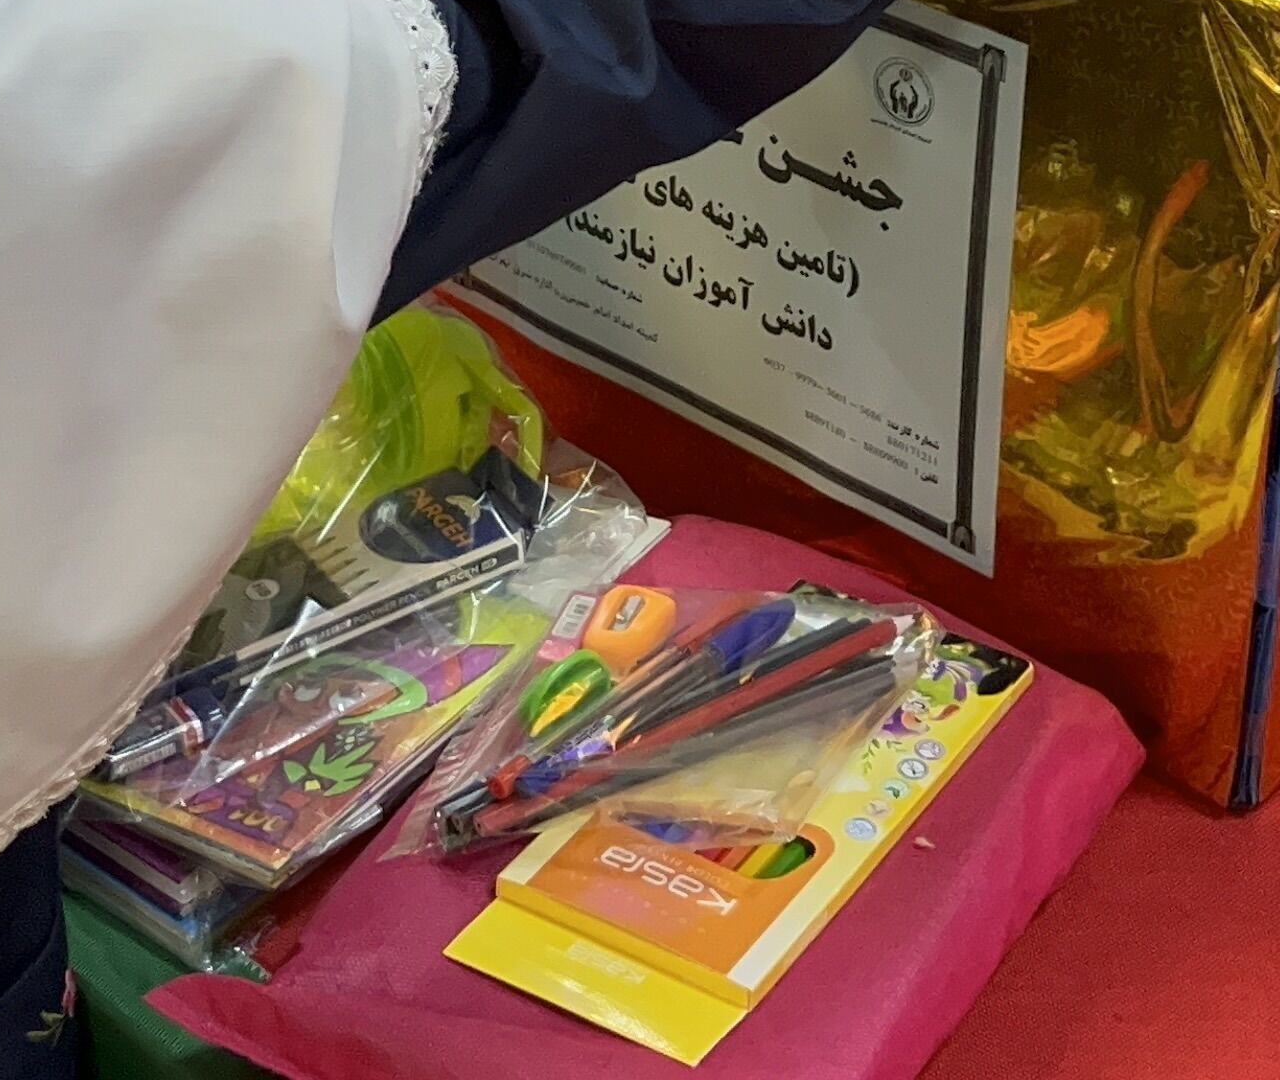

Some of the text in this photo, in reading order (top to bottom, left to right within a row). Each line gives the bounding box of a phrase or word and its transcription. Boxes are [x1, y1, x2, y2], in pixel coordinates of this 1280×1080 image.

[758, 133, 903, 231] جشن
[643, 175, 860, 298] (تامین هزینه های
[663, 254, 754, 310] آموزان
[761, 303, 833, 351] دانش
[600, 845, 737, 916] Kasra
